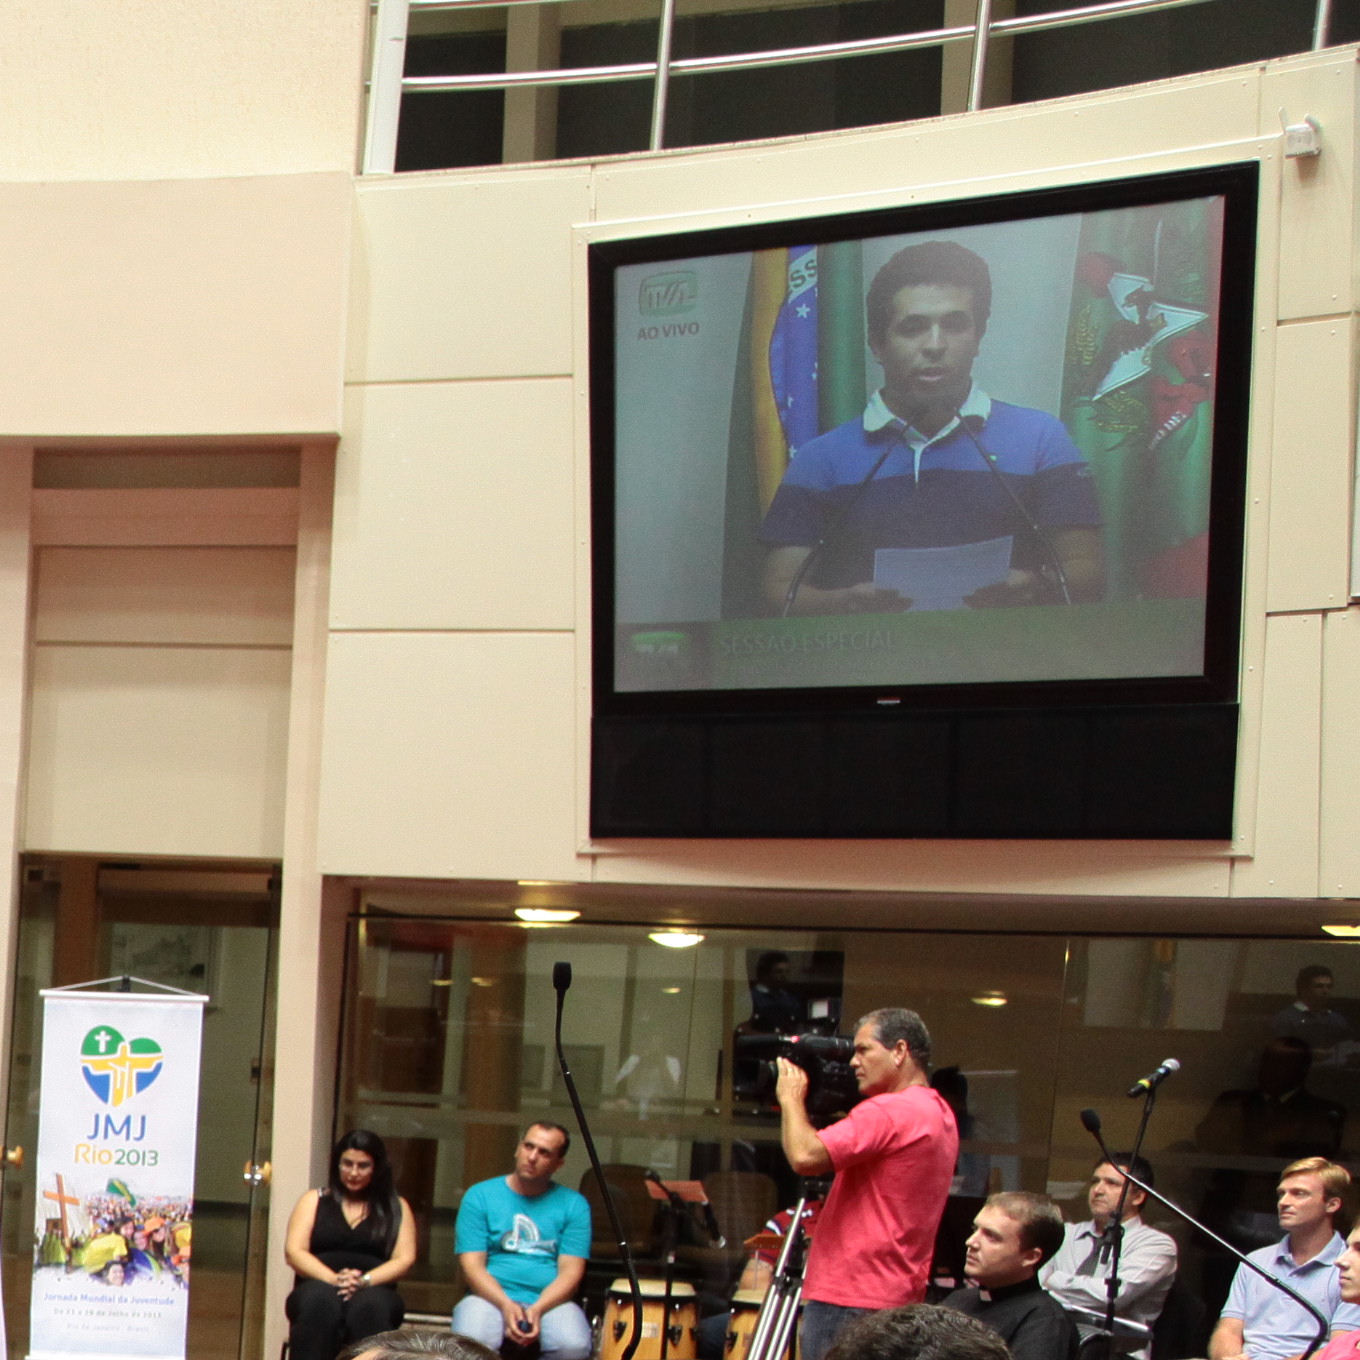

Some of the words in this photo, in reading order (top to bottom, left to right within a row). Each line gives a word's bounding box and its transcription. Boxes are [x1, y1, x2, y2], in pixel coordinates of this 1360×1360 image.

[637, 326, 659, 341] AO
[662, 321, 700, 338] VIVO
[86, 1113, 147, 1142] JMJ
